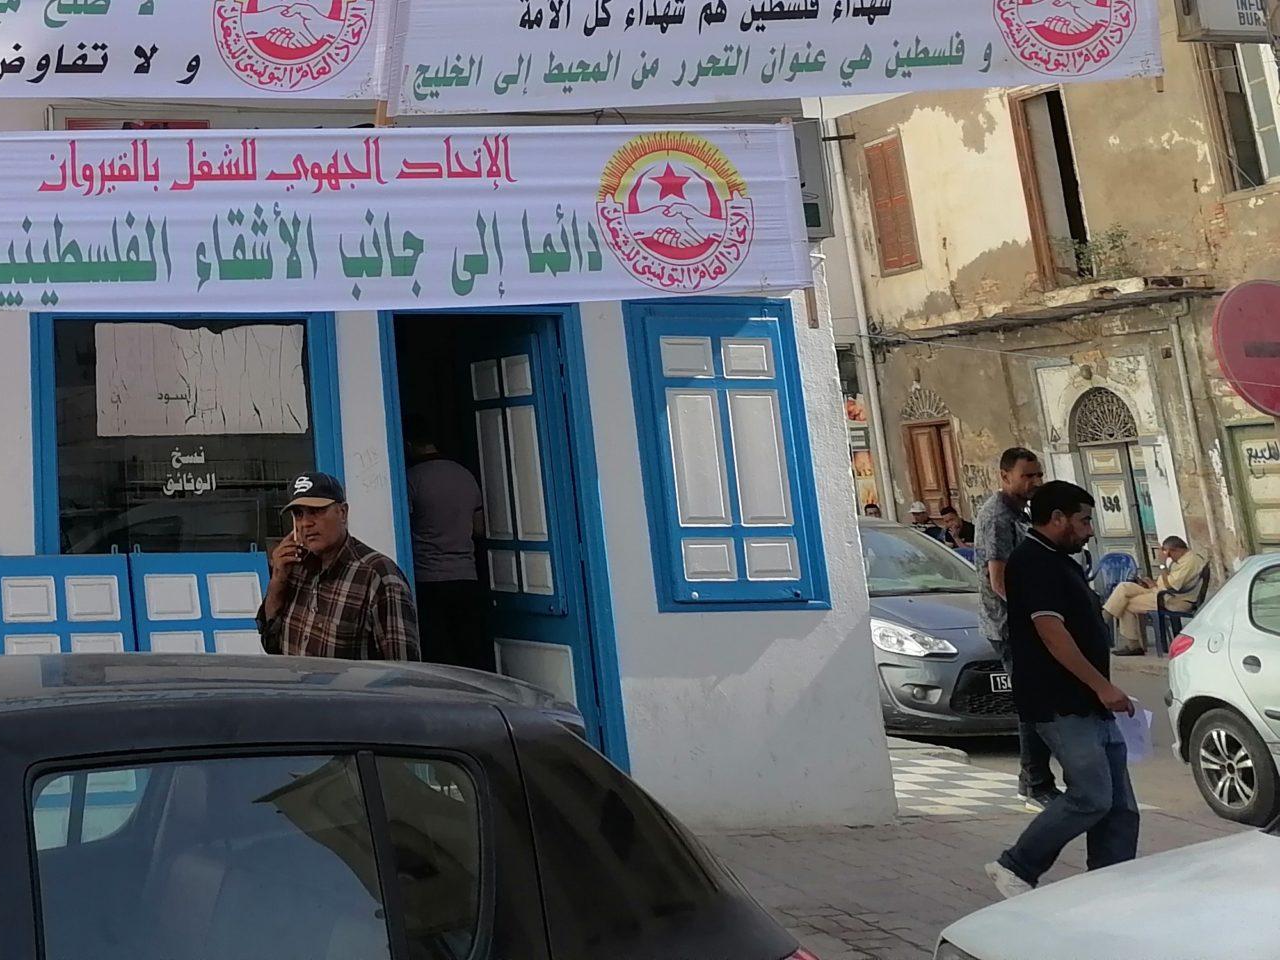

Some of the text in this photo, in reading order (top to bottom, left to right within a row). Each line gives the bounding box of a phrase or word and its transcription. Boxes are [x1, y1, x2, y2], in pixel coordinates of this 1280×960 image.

[1238, 12, 1266, 26] BUR
[134, 44, 159, 74] لا
[176, 55, 200, 84] و
[413, 32, 992, 101] و فلسطين هي عنوان التحرر من المحيط إلى الخليج
[37, 133, 517, 196] الإتحاد الجهوي للشغل بالقيروان
[196, 202, 317, 292] الأشقاء
[340, 209, 424, 300] جانب
[452, 211, 505, 298] إلى
[522, 201, 603, 277] دائما
[162, 472, 217, 496] الوثائق
[170, 446, 205, 469] نسخ
